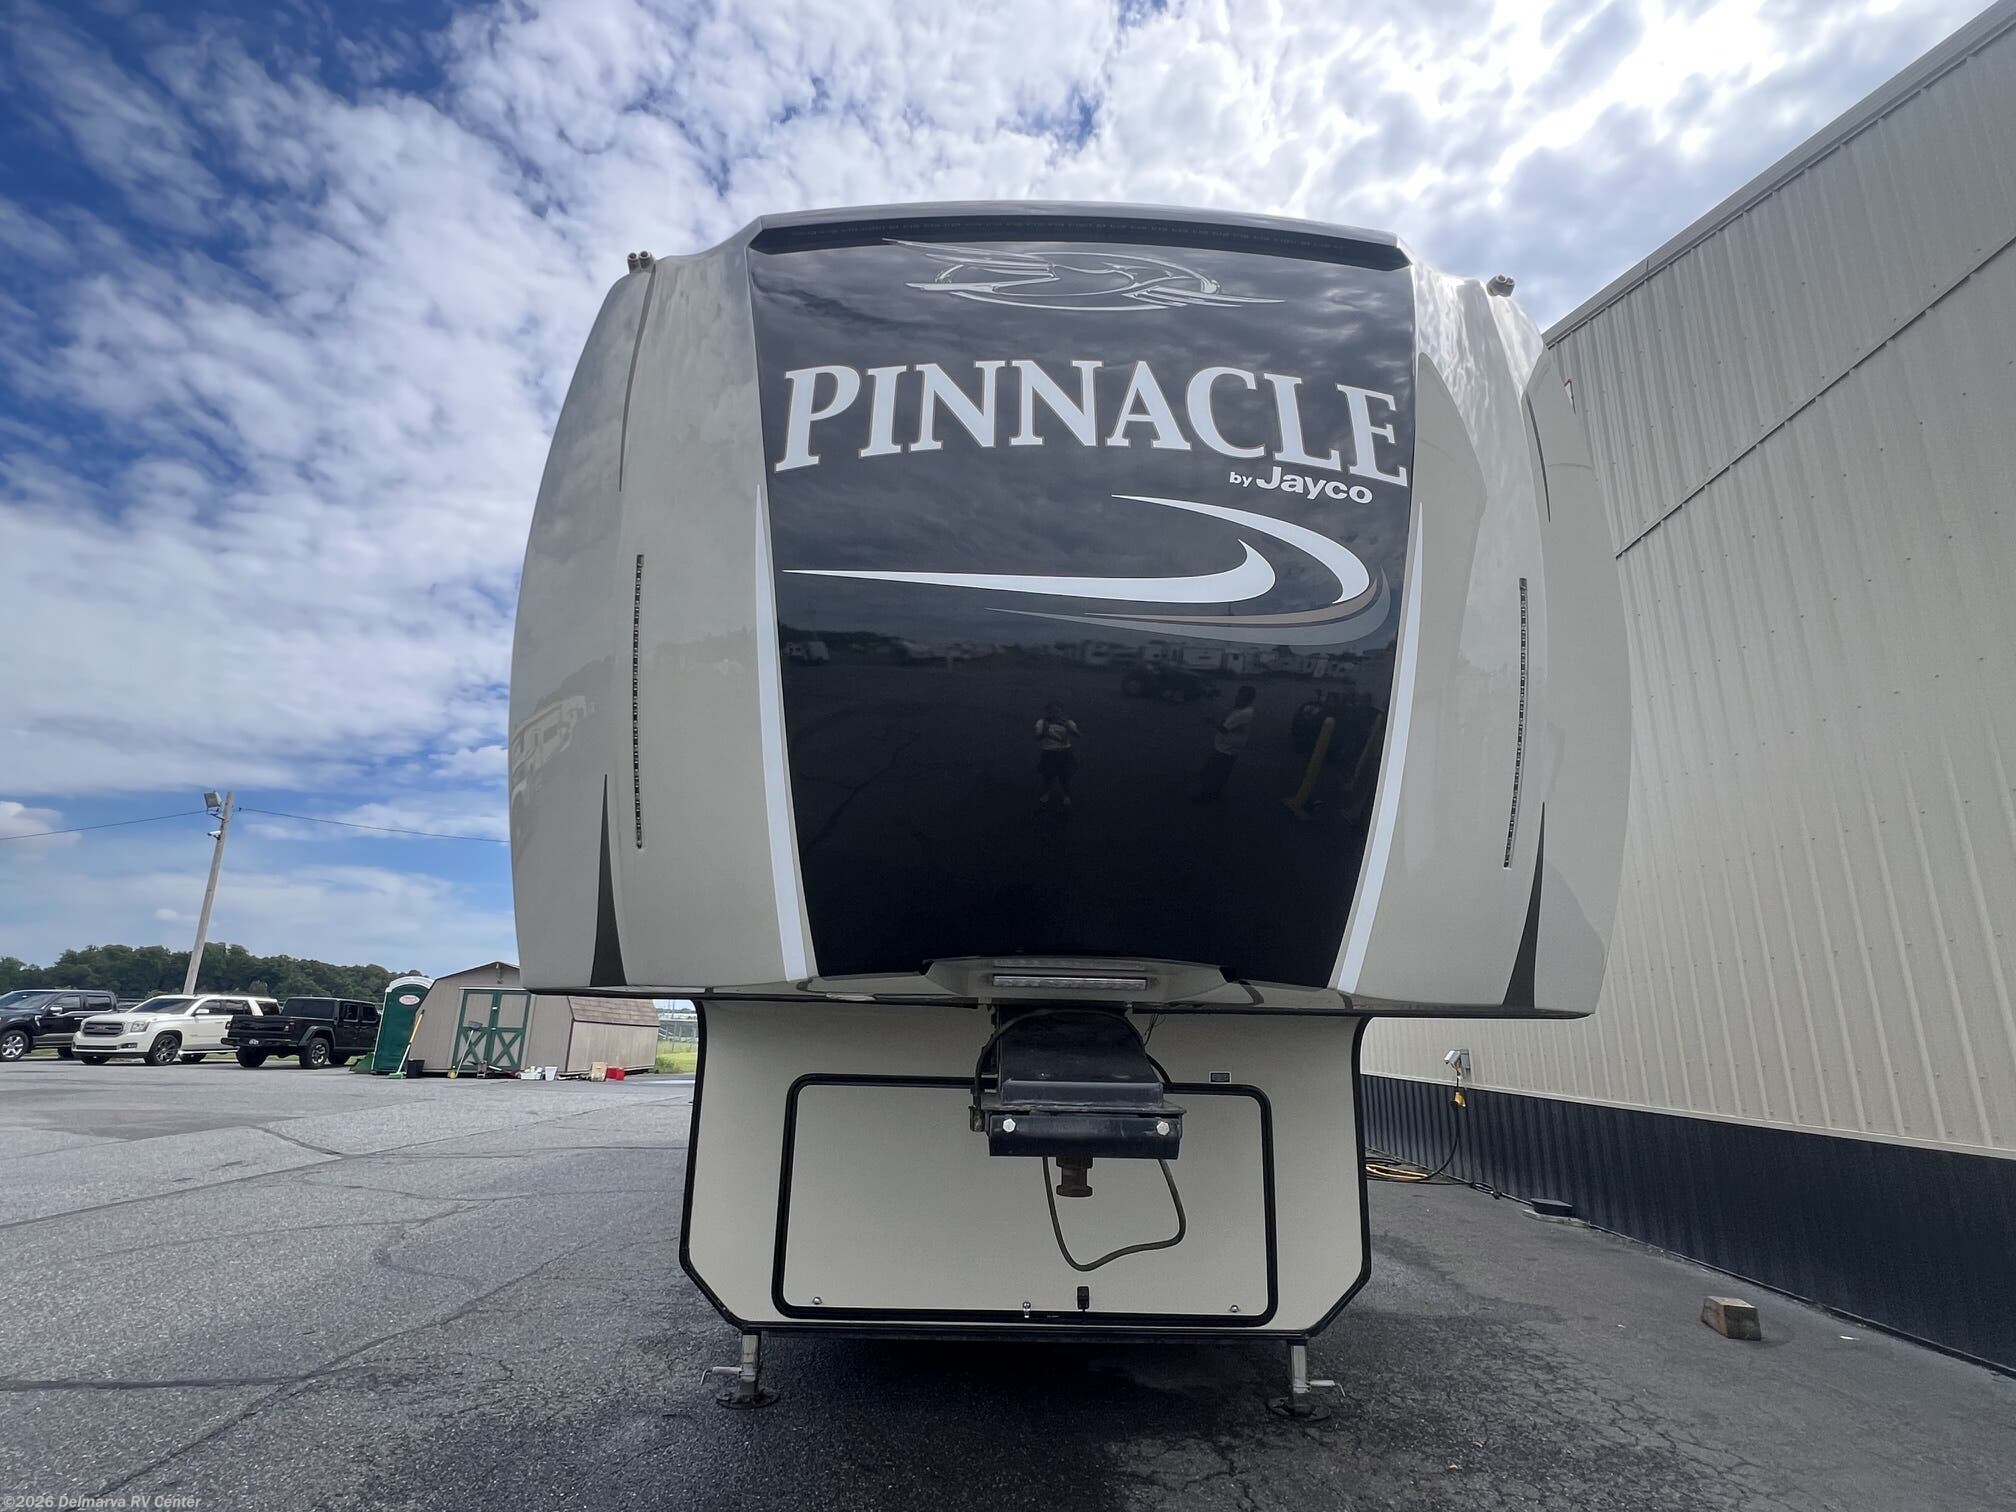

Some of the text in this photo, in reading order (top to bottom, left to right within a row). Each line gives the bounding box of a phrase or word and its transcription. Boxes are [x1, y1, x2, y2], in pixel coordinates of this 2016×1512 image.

[775, 360, 1408, 486] PINNACLE
[1229, 466, 1373, 504] by Jayco
